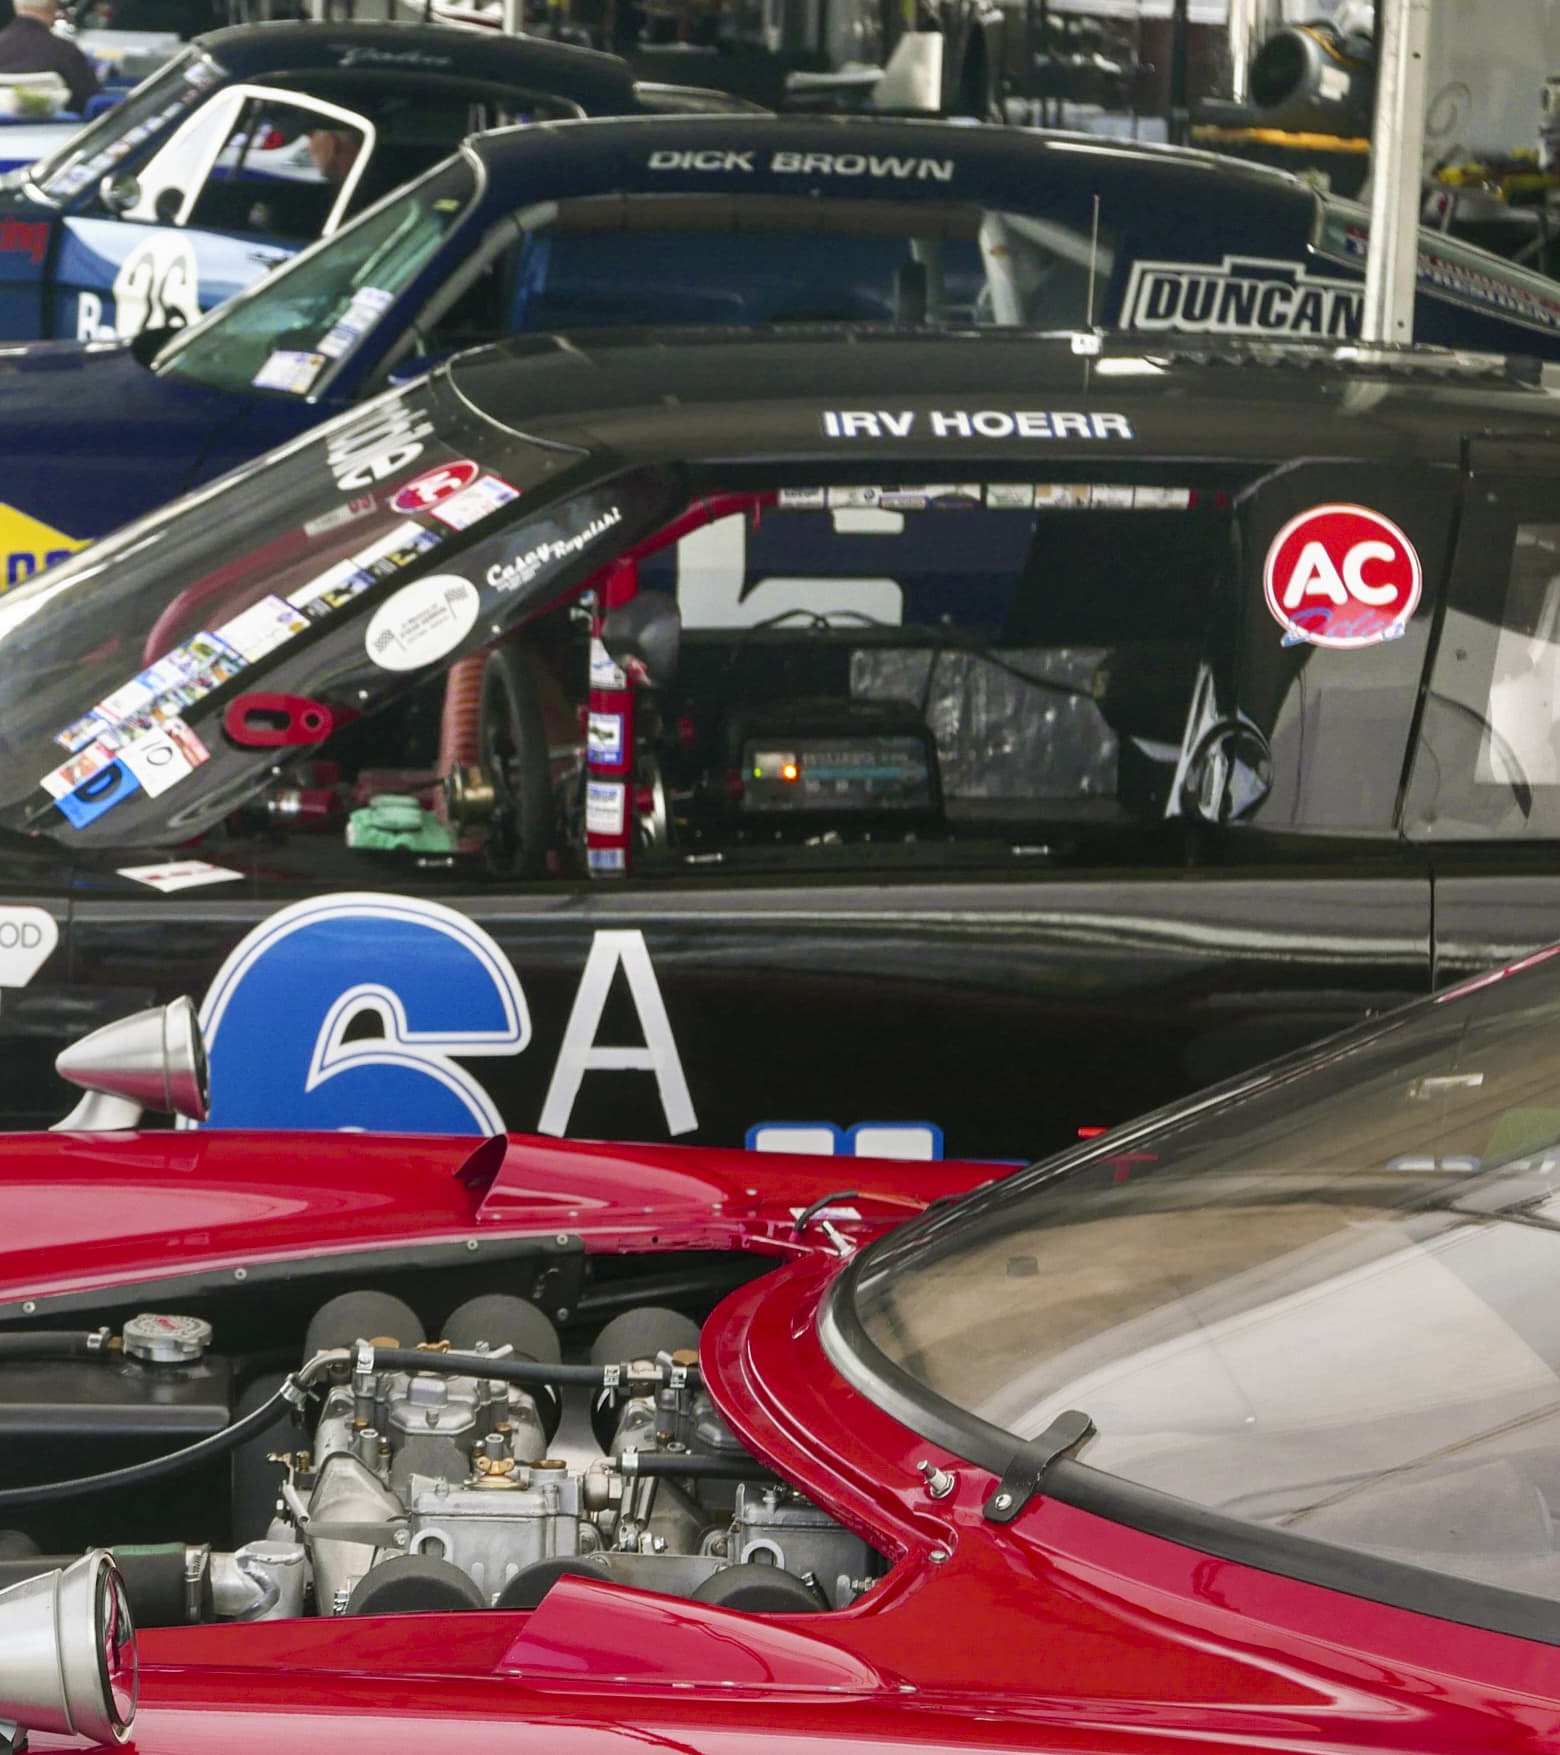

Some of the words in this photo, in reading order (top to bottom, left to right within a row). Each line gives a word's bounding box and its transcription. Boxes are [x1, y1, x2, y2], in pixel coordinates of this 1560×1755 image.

[648, 151, 753, 171] DICK
[771, 153, 954, 180] BROWN
[1134, 272, 1366, 337] DUNCAN
[824, 411, 913, 437] IRV
[930, 411, 1132, 439] HOERR
[1283, 540, 1399, 609] AC
[177, 892, 532, 1137] 6
[537, 929, 699, 1137] A
